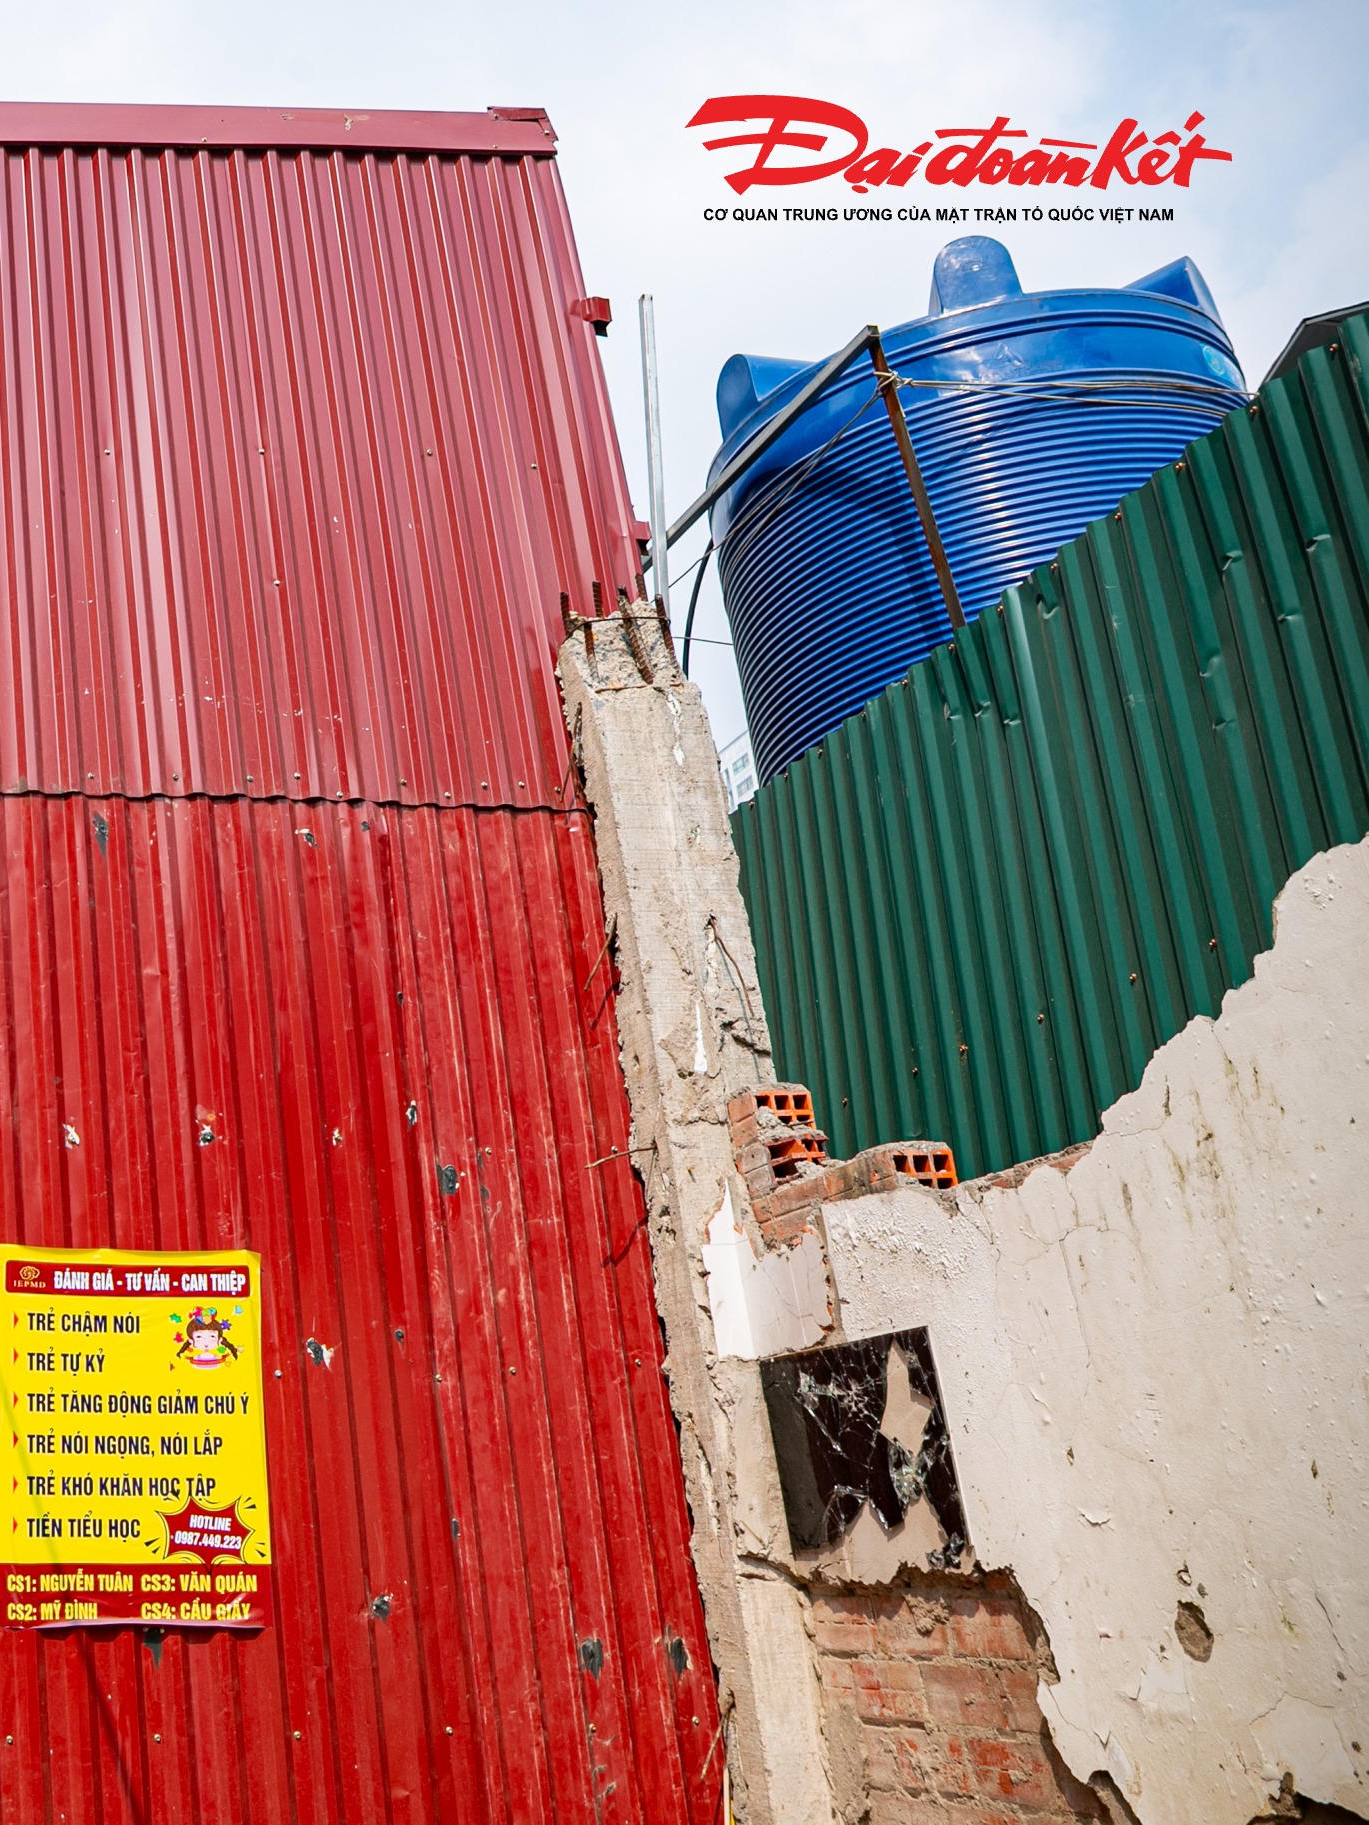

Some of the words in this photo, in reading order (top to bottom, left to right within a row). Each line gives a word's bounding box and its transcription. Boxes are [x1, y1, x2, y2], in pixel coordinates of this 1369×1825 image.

[13, 1280, 47, 1289] IEPMD
[53, 1267, 90, 1291] ĐÁNH
[92, 1269, 115, 1291] GIÁ
[125, 1271, 142, 1291] TƯ
[143, 1267, 170, 1291] VẤN
[181, 1273, 208, 1292] CAN
[210, 1270, 246, 1295] THIỆP
[27, 1306, 55, 1332] TRẺ
[61, 1311, 108, 1337] CHẬM
[113, 1312, 140, 1334] NÓI
[27, 1346, 55, 1372] TRẺ
[60, 1352, 81, 1376] TỰ
[85, 1348, 106, 1373] KỶ
[27, 1387, 55, 1412] TRẺ
[60, 1390, 103, 1413] TĂNG
[108, 1391, 152, 1418] ĐỘNG
[157, 1389, 199, 1415] GIẢM
[204, 1391, 235, 1414] CHÚ
[241, 1392, 249, 1415] Ý
[27, 1427, 55, 1454] TRẺ
[61, 1431, 89, 1454] NÓI
[94, 1435, 155, 1459] NGỌNG,
[160, 1432, 188, 1455] NÓI
[193, 1429, 223, 1455] LẮP
[27, 1469, 55, 1495] TRẺ
[61, 1472, 94, 1496] KHÓ
[99, 1473, 143, 1496] KHĂN
[186, 1473, 216, 1500] TẬP
[27, 1512, 62, 1538] TIỀN
[68, 1510, 103, 1538] TIỂU
[108, 1518, 141, 1543] HỌC
[189, 1514, 232, 1532] HOTLINE
[174, 1530, 242, 1550] 0987.449.223
[7, 1574, 37, 1592] CS1:
[39, 1567, 95, 1592] NGUYỄN
[97, 1571, 134, 1592] TUÂN
[140, 1573, 176, 1592] CS3:
[179, 1570, 211, 1592] VĂN
[215, 1571, 258, 1594] QUÁN
[7, 1602, 37, 1620] CS2:
[40, 1599, 62, 1620] MỸ
[64, 1598, 98, 1620] ĐÌNH
[140, 1602, 176, 1620] CS4:
[179, 1597, 212, 1620] CẦU
[215, 1597, 251, 1620] GIẤY
